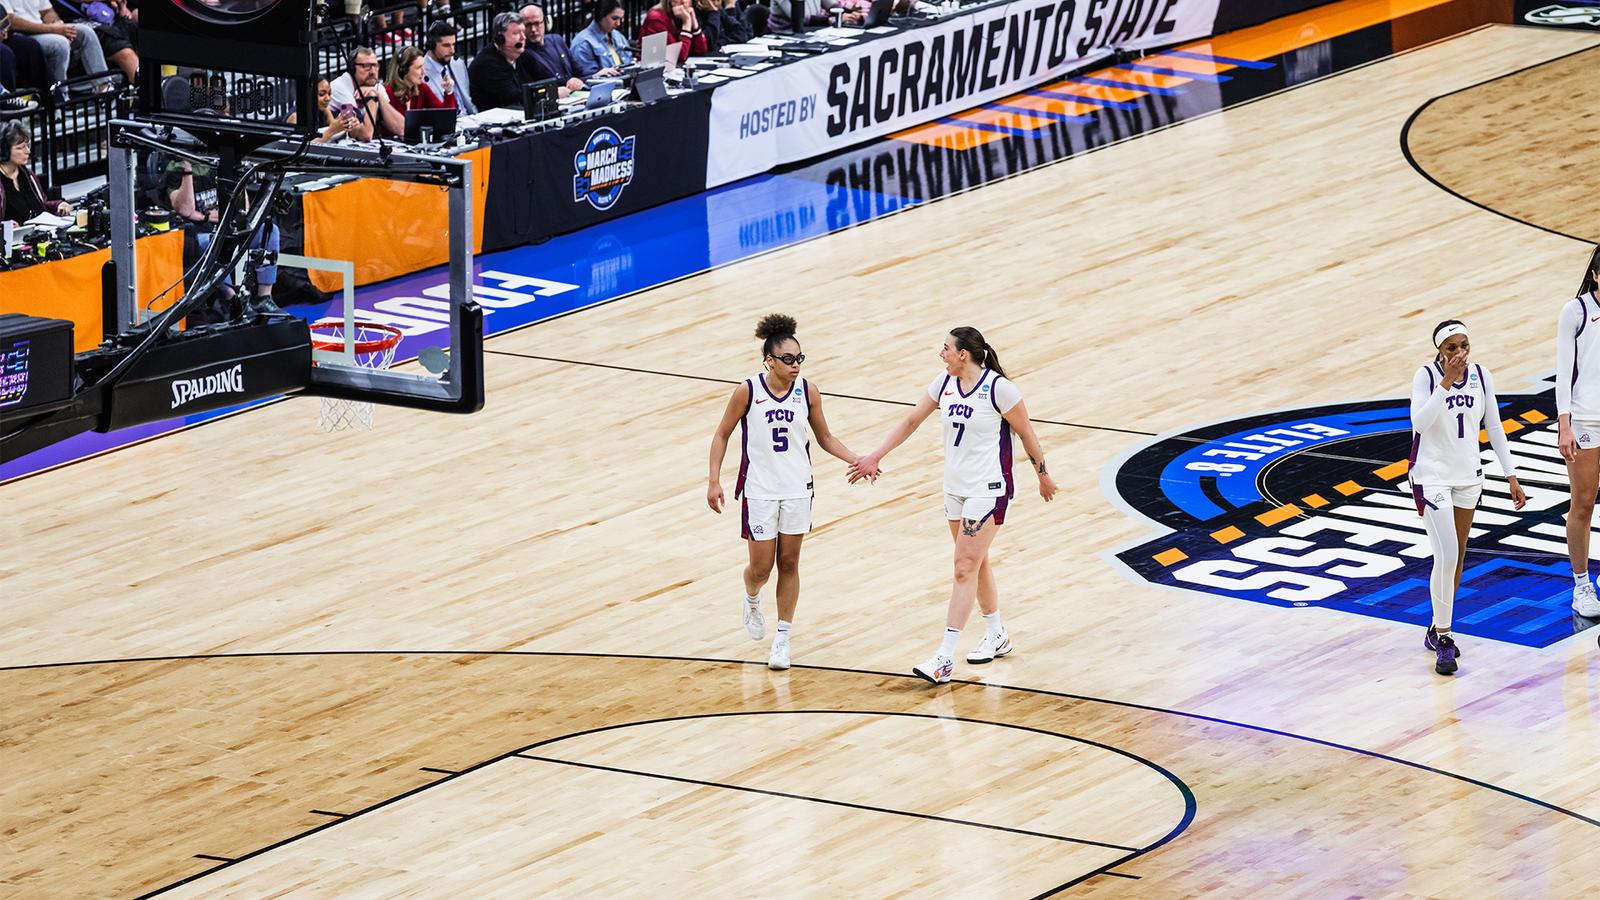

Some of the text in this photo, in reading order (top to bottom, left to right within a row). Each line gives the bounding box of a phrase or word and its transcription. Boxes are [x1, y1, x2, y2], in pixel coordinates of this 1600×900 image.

[826, 0, 1076, 138] SACRAMENTO
[1076, 0, 1178, 58] STATE
[739, 93, 817, 140] HOSTED BY
[586, 146, 618, 171] MARCH
[590, 159, 633, 187] MADNESS
[314, 270, 580, 337] FOUR
[171, 363, 245, 409] SPALDING
[948, 403, 974, 420] TCU
[1445, 394, 1475, 411] TCU
[765, 408, 795, 424] TCU
[1456, 413, 1465, 438] 1
[772, 427, 788, 452] 5
[952, 421, 965, 447] 7
[1184, 422, 1350, 473] ELITE 8
